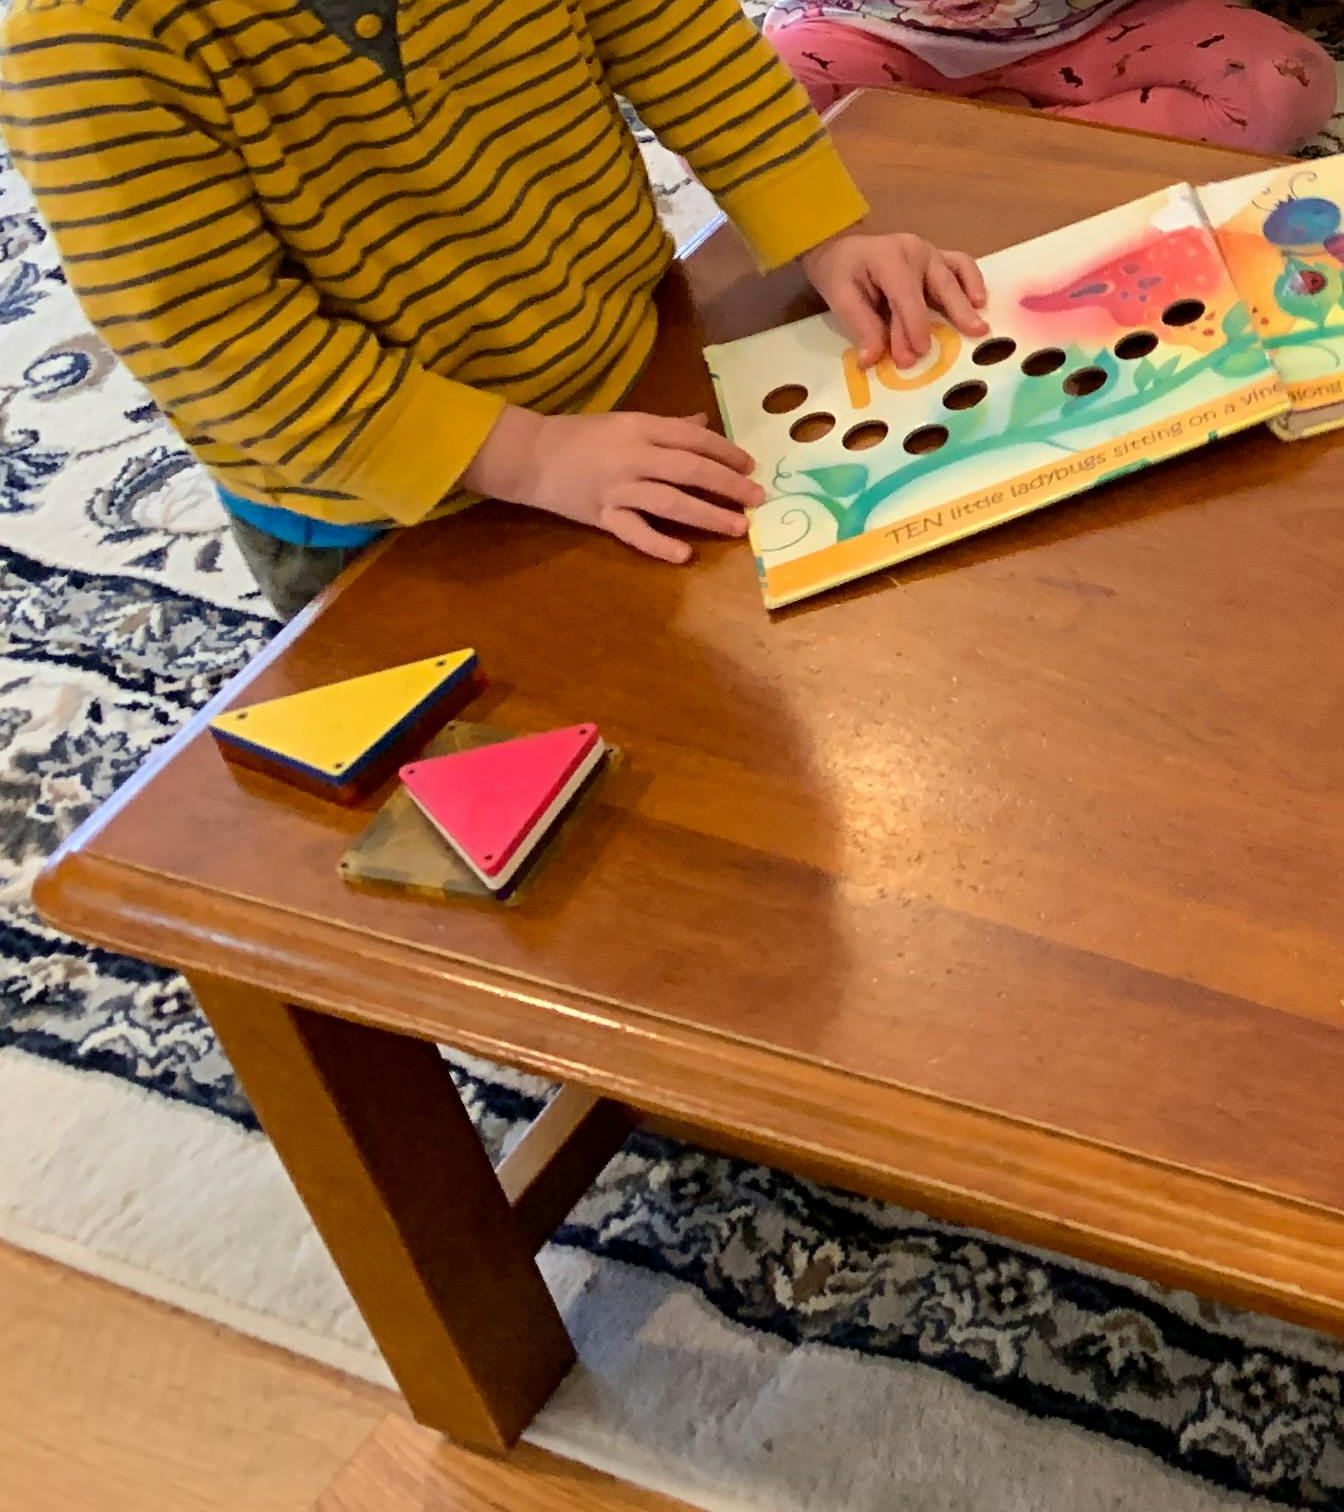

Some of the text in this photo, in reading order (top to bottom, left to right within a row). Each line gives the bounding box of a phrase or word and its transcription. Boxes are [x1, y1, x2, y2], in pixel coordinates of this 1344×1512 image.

[885, 511, 943, 545] TEN
[950, 490, 1004, 523] little
[1010, 451, 1107, 499] ladybugs
[1113, 422, 1183, 457] sitting
[1187, 407, 1217, 427] on
[1224, 400, 1237, 416] a
